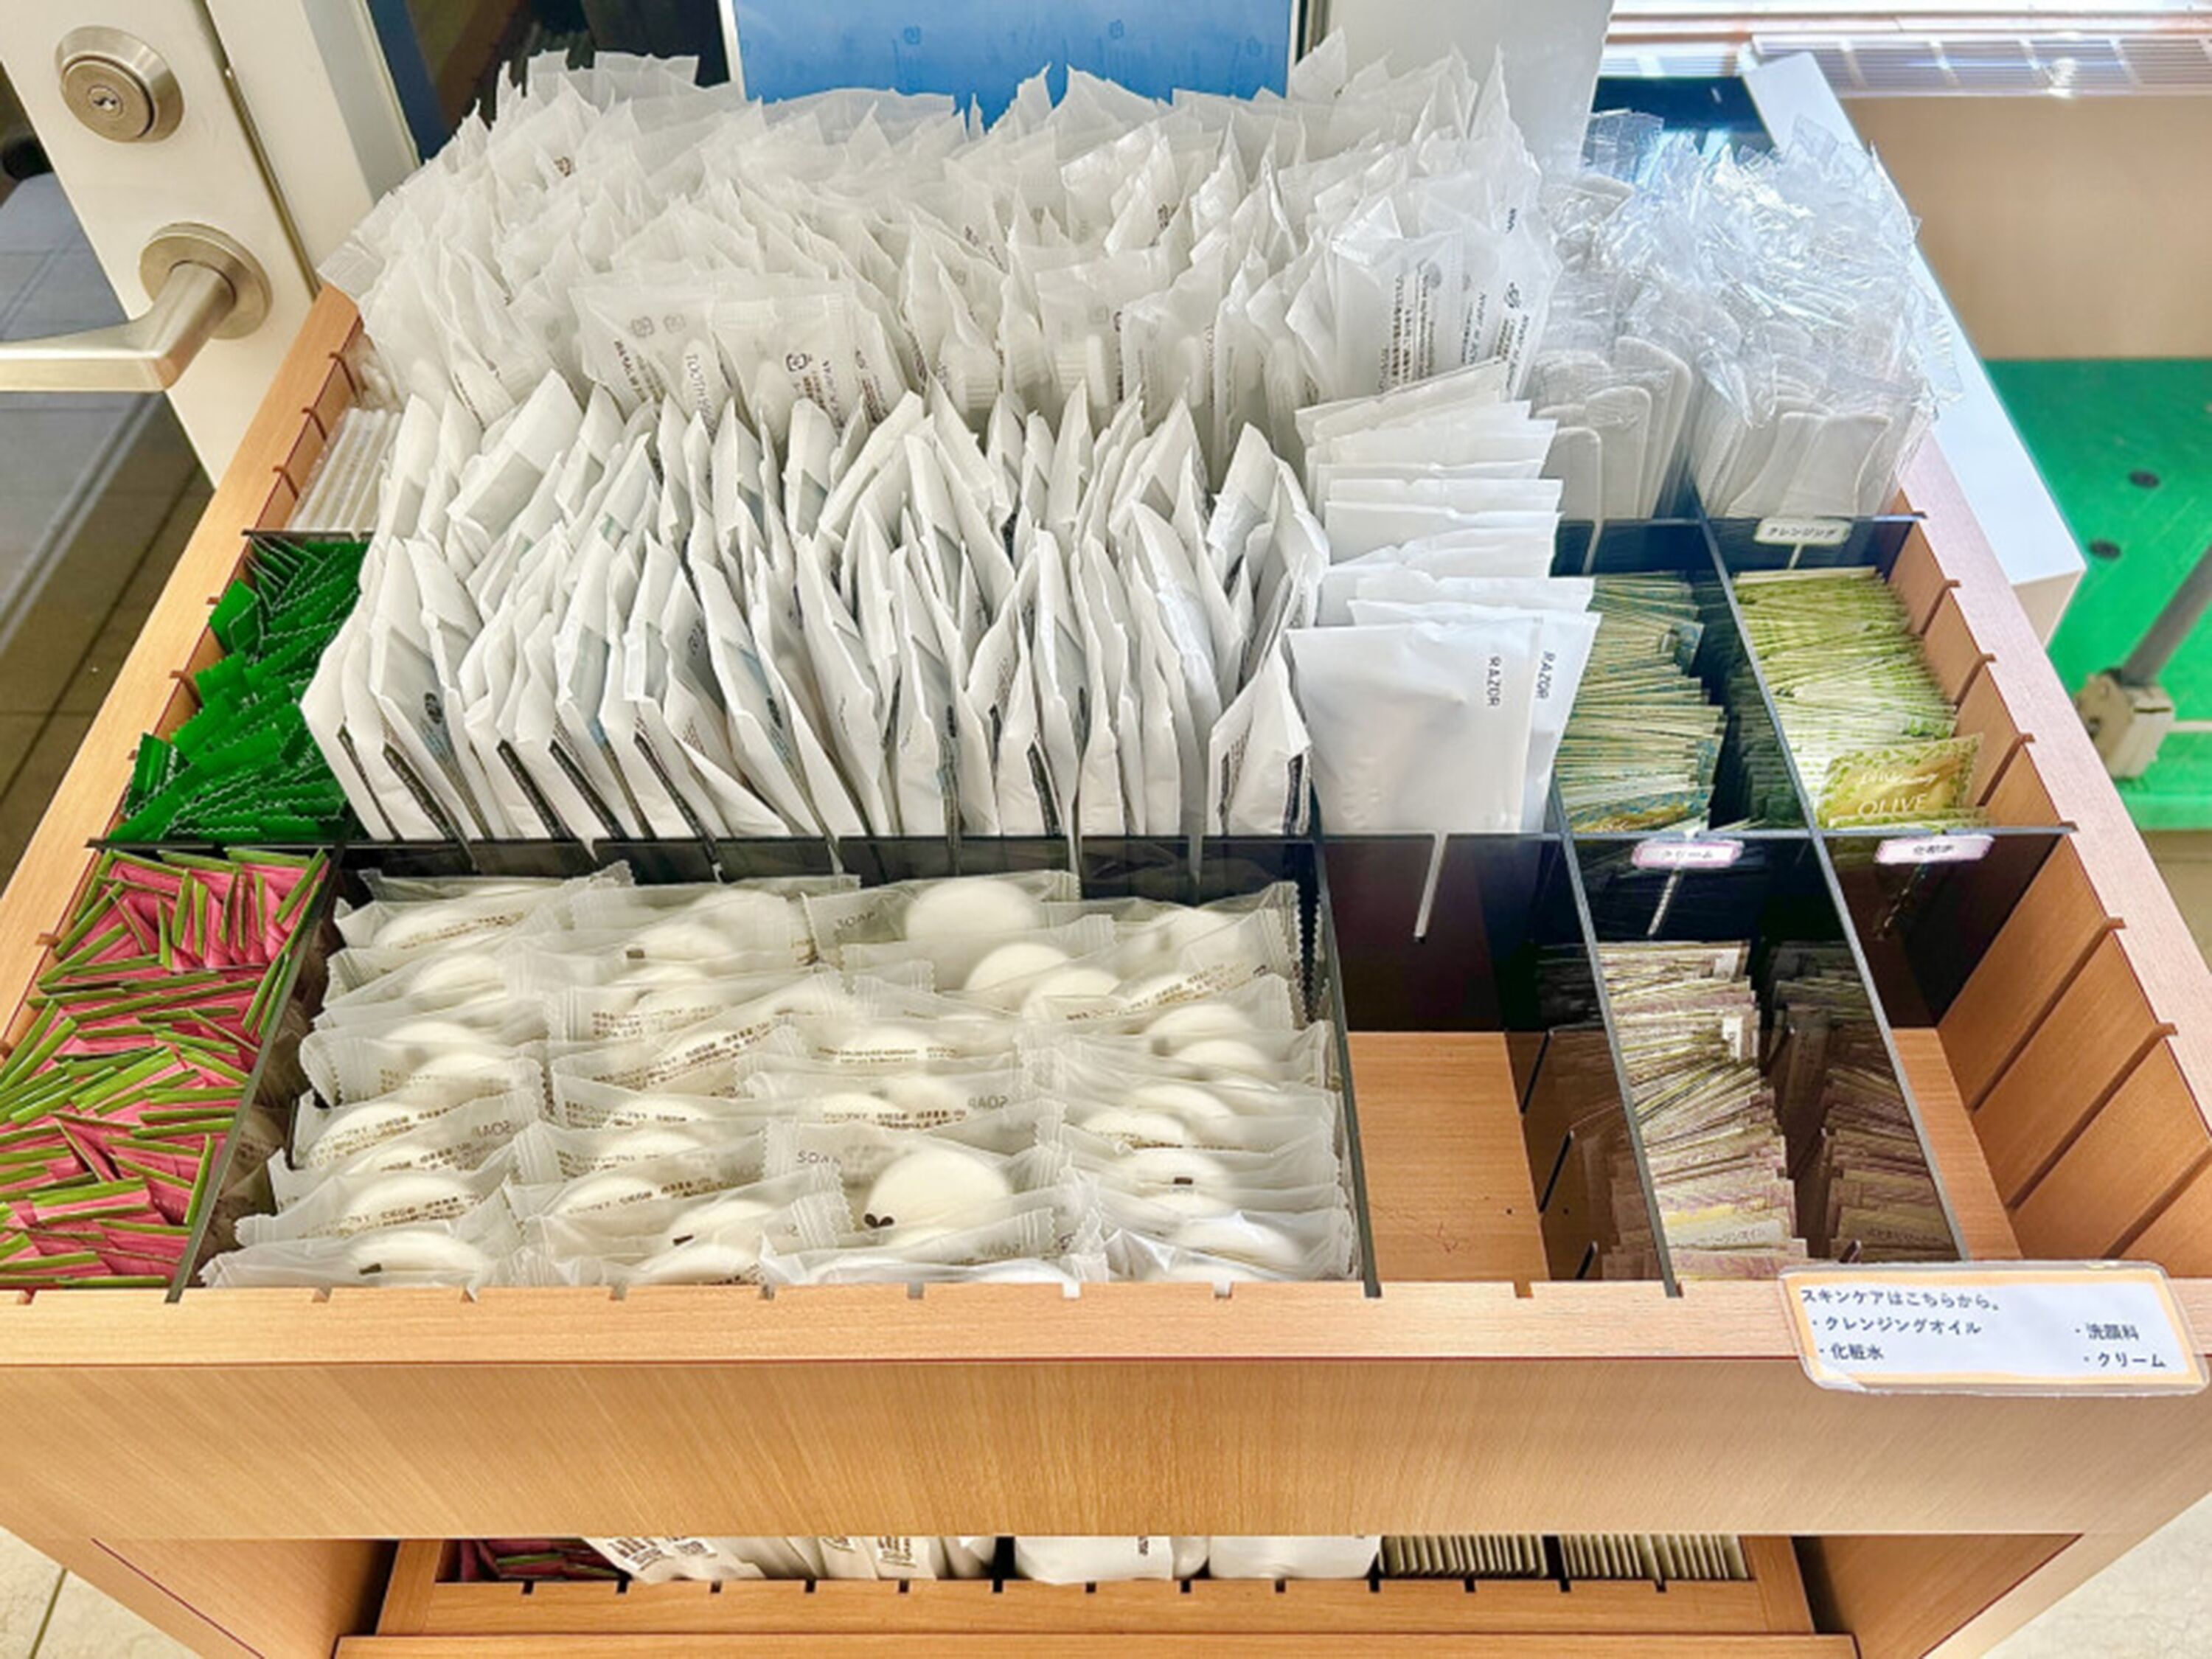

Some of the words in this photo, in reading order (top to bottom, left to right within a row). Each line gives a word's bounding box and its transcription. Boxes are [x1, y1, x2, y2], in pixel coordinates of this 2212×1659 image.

[1486, 655, 1502, 707] RAZOR
[1534, 650, 1557, 700] RAZOR
[1857, 792, 1928, 818] OLIVE
[1801, 1289, 2000, 1312] スキンケアはこちらから。
